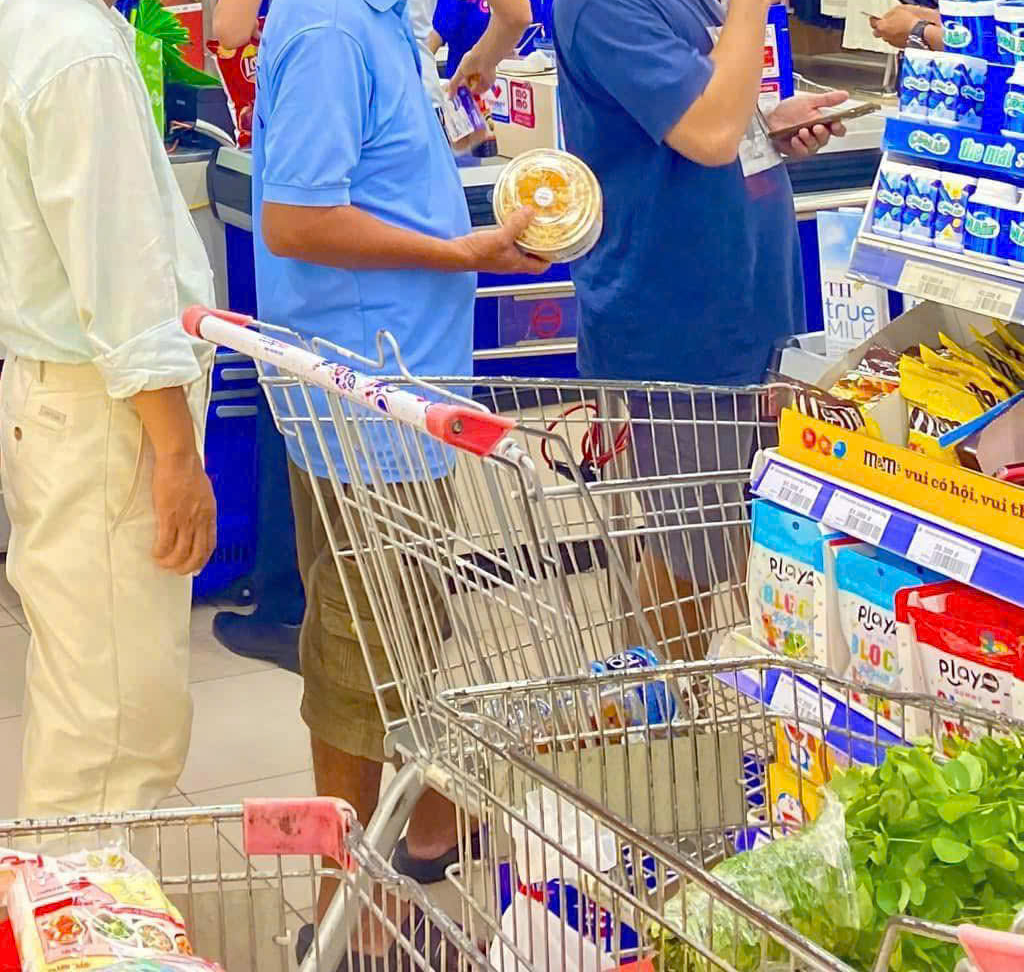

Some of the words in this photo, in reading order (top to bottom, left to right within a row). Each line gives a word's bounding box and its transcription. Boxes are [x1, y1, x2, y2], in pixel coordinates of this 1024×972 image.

[826, 298, 875, 323] true
[827, 321, 875, 341] MILK
[905, 467, 929, 486] vui
[931, 477, 948, 493] có
[950, 480, 978, 504] hội,
[980, 493, 1007, 513] vui
